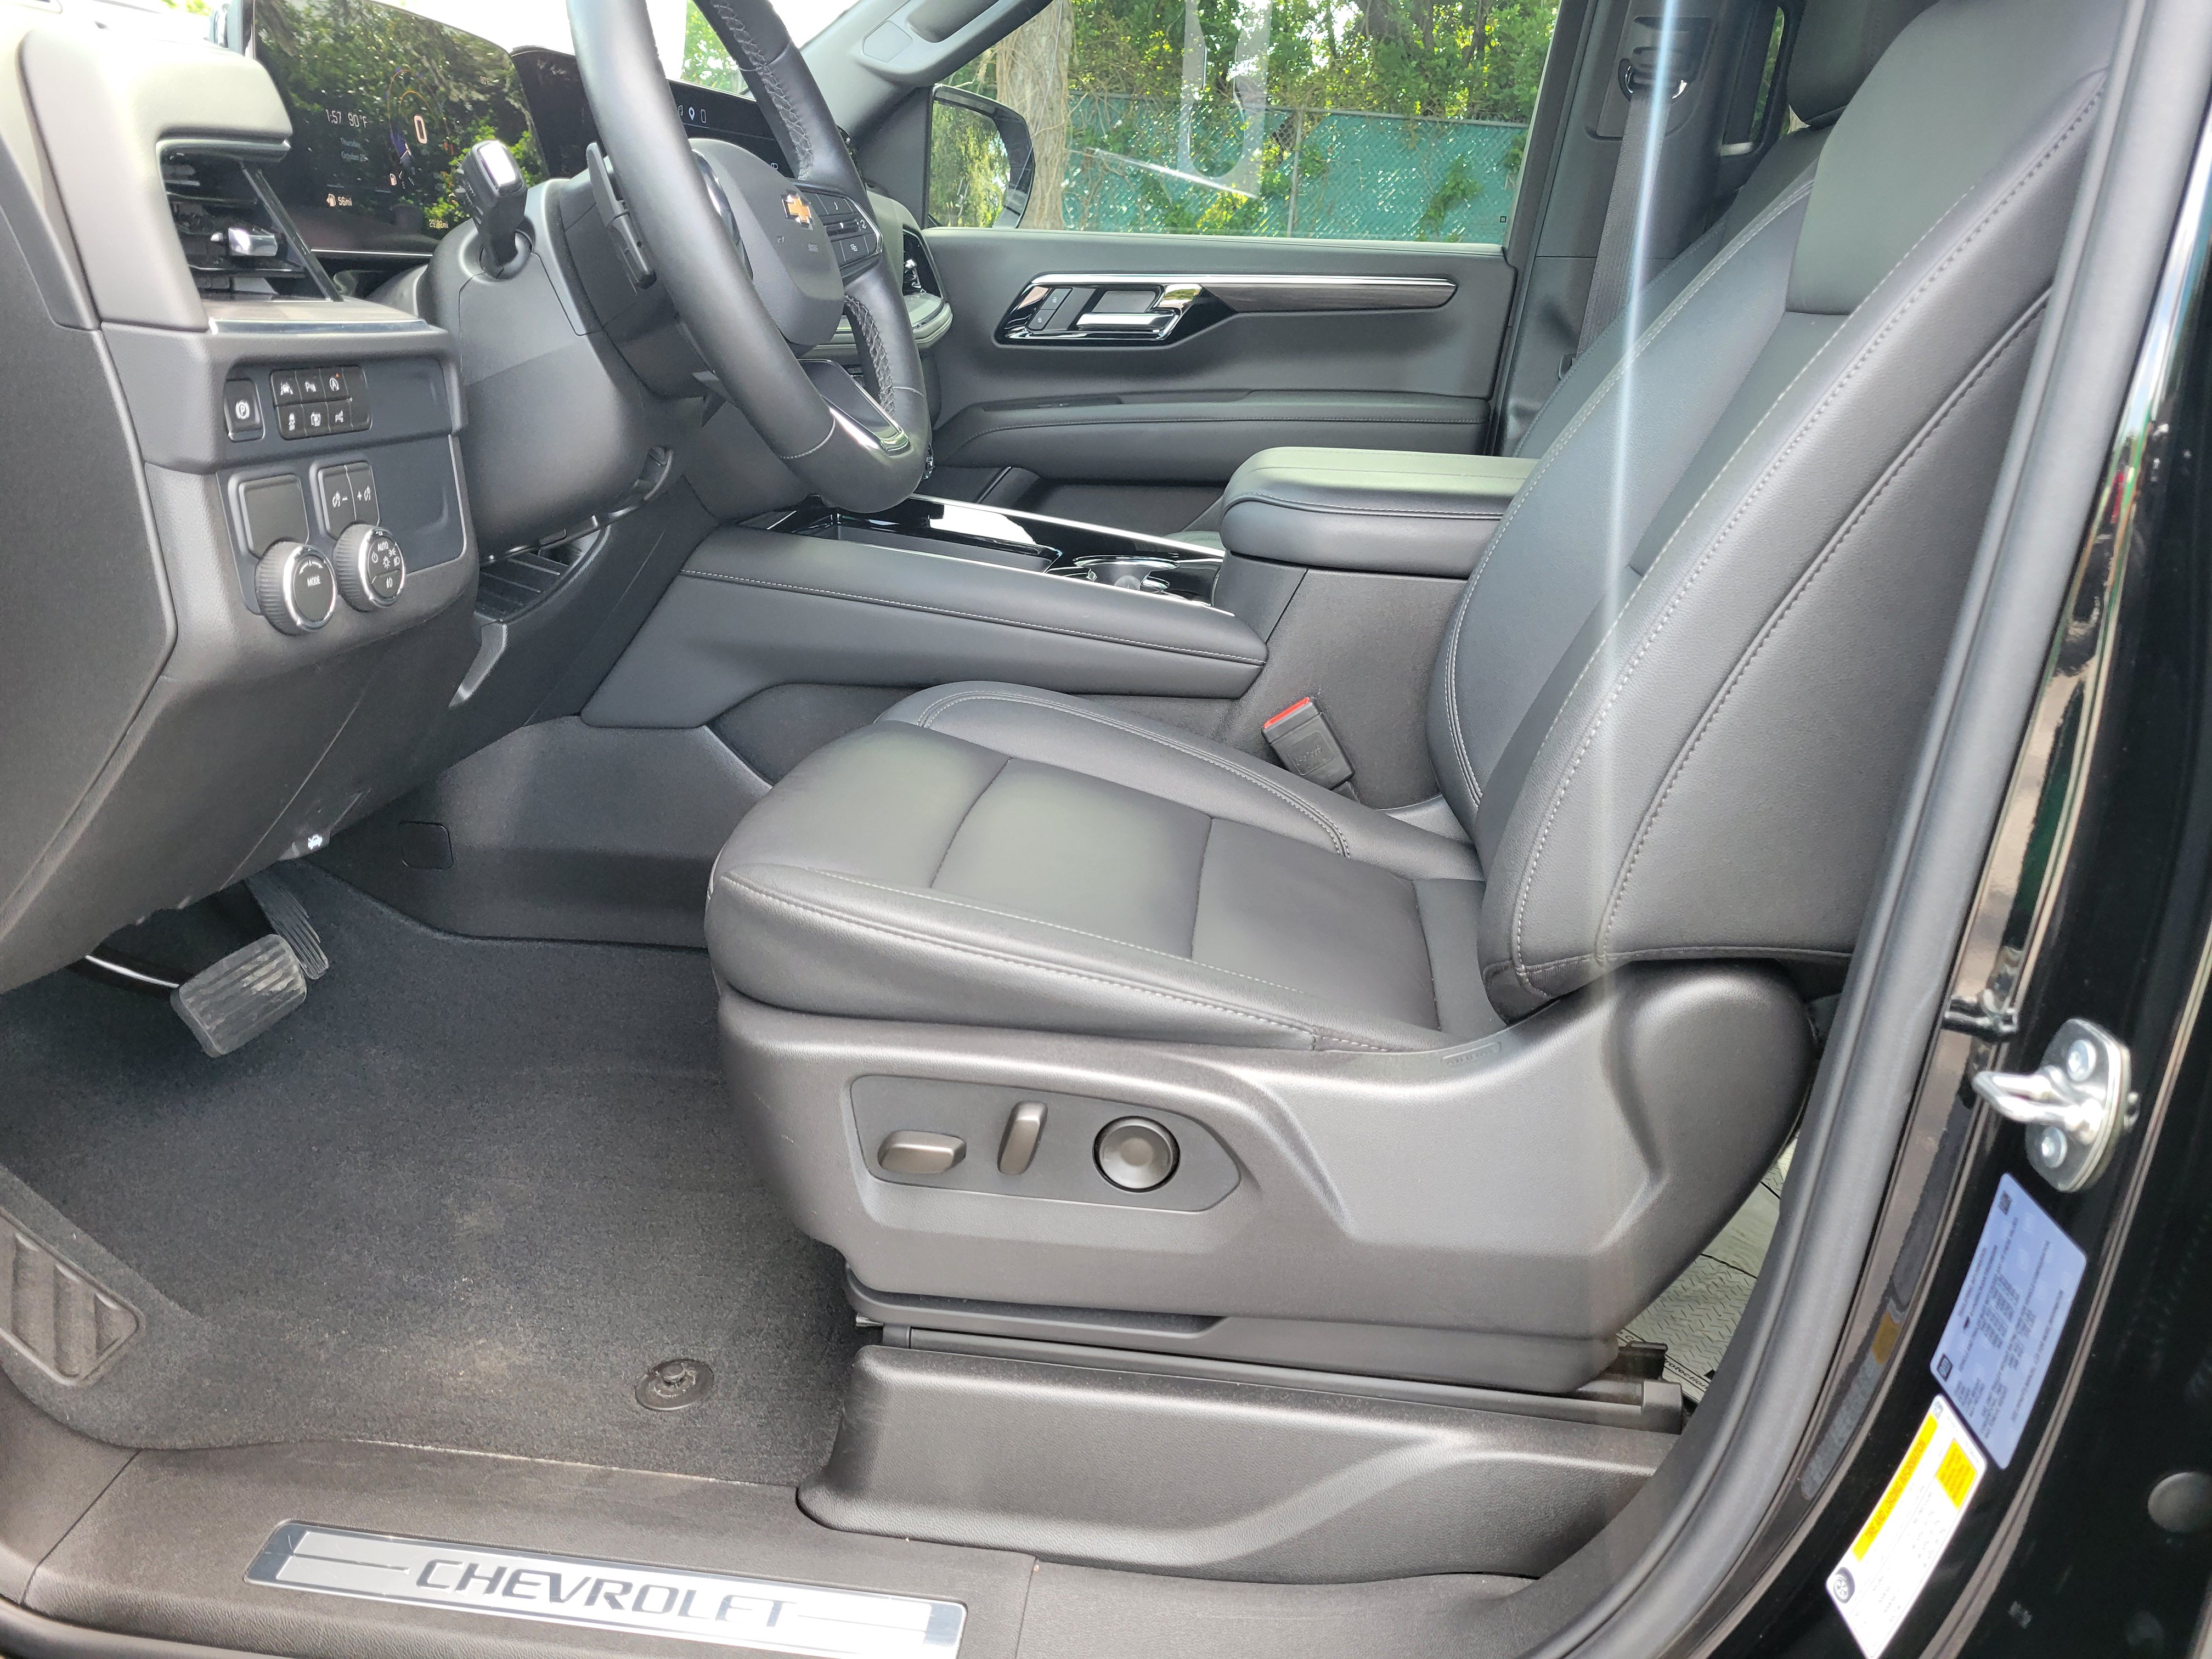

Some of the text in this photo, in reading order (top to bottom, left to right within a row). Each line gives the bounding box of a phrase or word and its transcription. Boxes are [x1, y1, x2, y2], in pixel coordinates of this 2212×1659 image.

[325, 109, 368, 128] 1:57 90°F
[414, 115, 427, 144] 0
[337, 196, 352, 206] 56mi
[377, 541, 388, 552] AUTO
[307, 575, 321, 587] MODE
[1865, 1525, 1877, 1542] TIRE
[1875, 1510, 1886, 1527] AND
[1881, 1482, 1903, 1515] LOADING
[1898, 1438, 1927, 1483] INFORMATION
[415, 1559, 797, 1627] CHEVROLET
